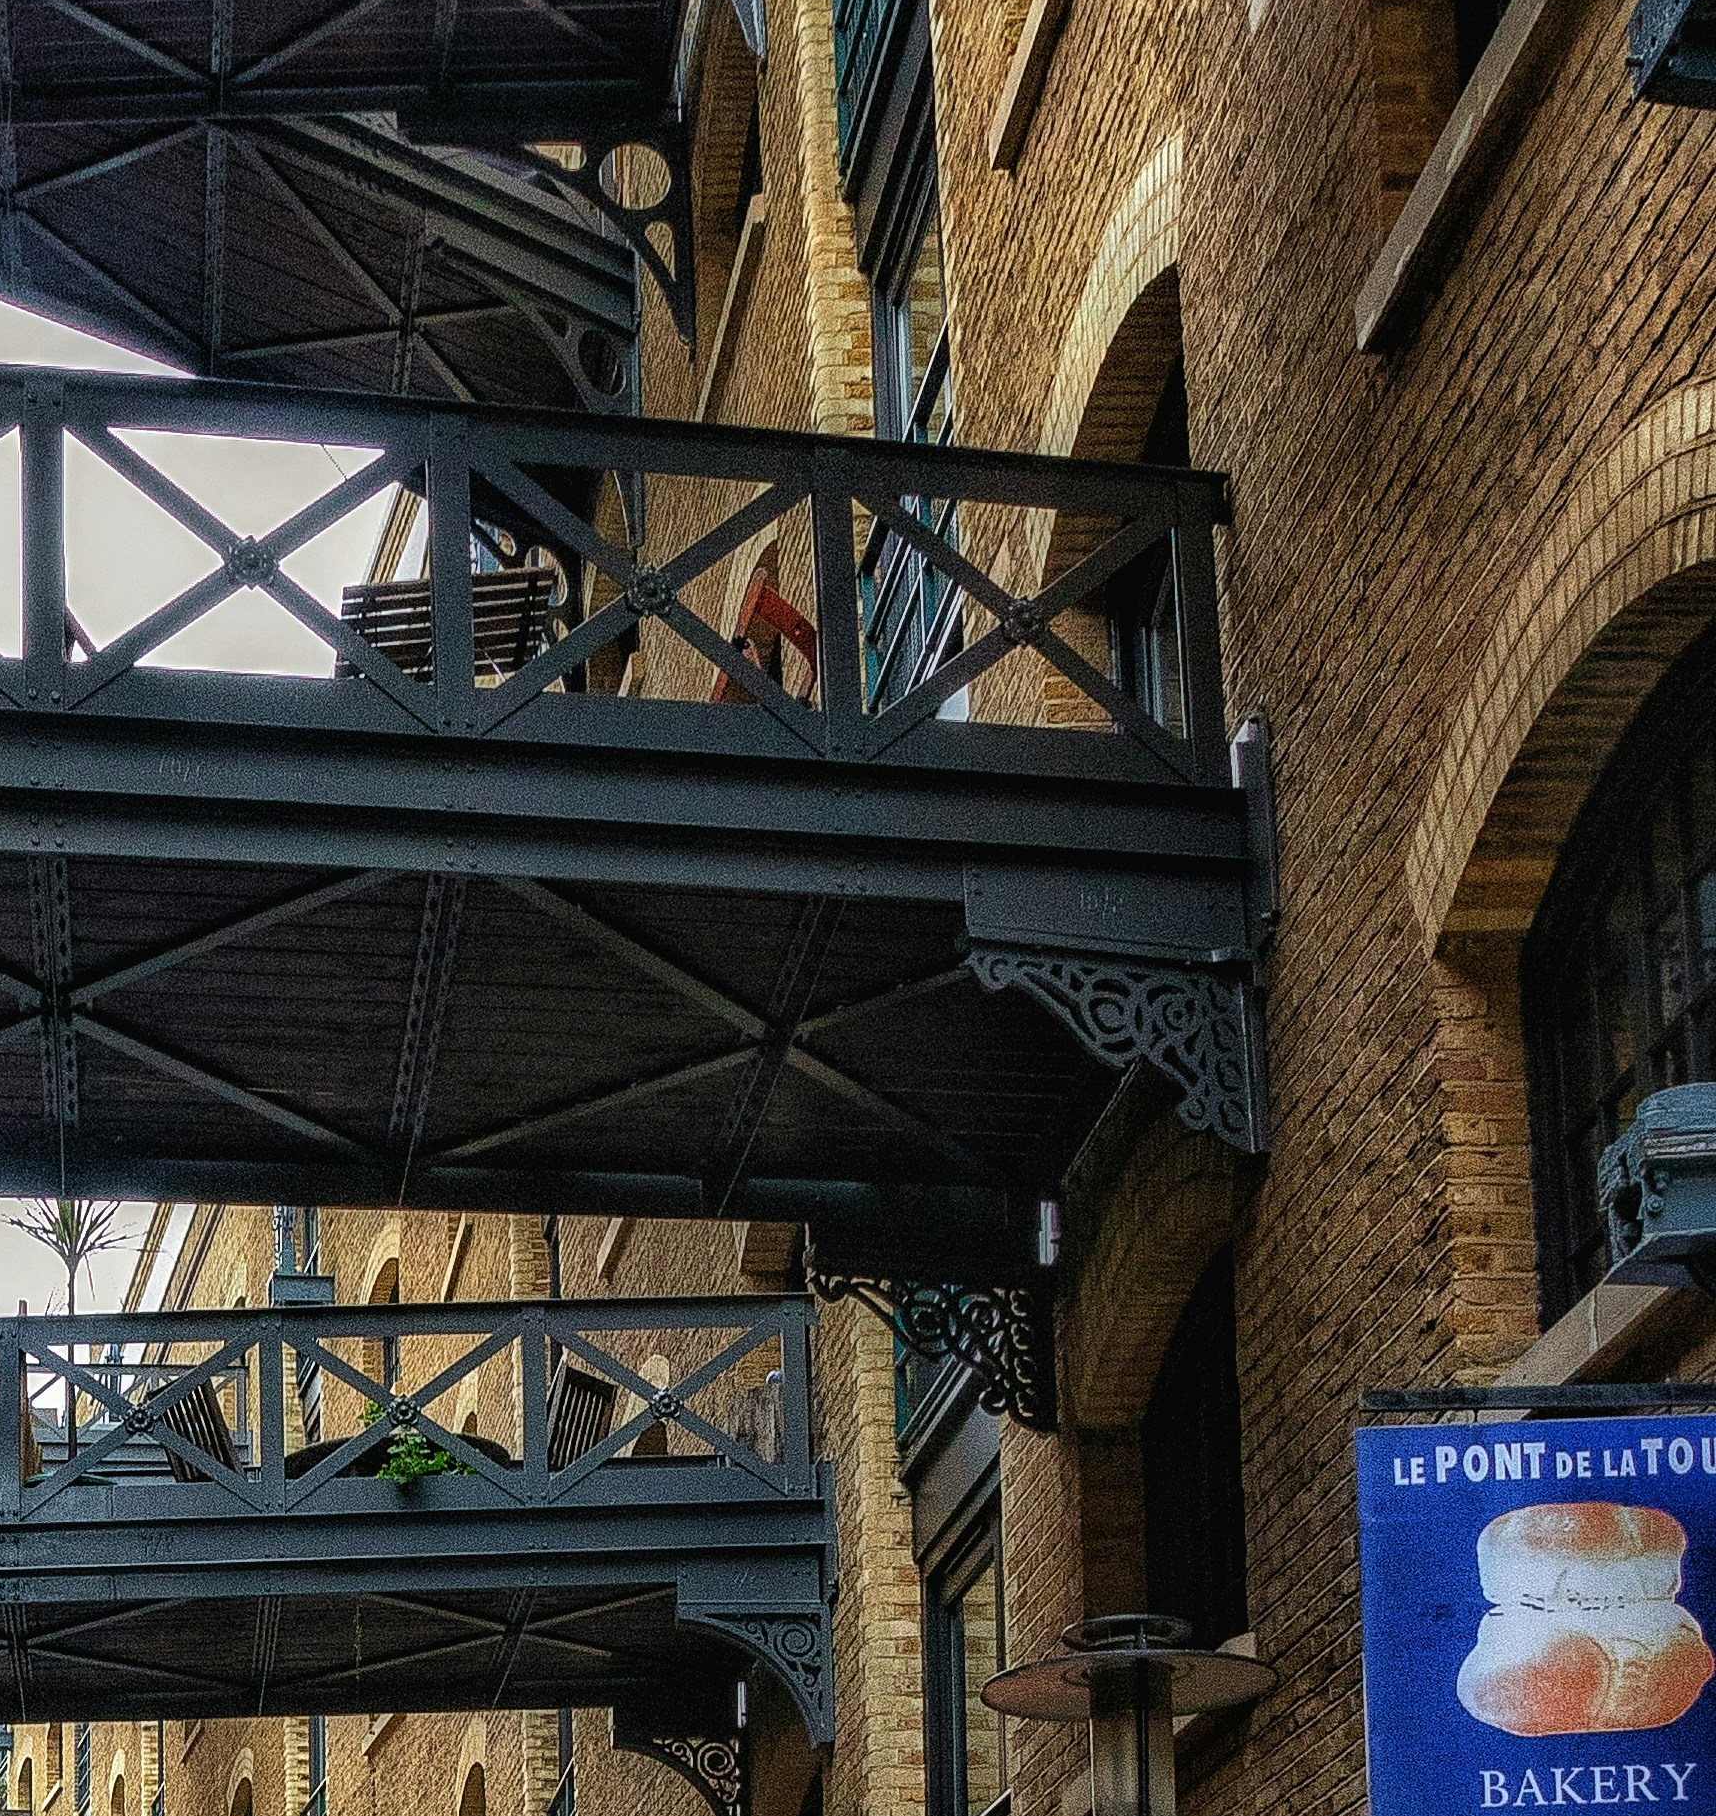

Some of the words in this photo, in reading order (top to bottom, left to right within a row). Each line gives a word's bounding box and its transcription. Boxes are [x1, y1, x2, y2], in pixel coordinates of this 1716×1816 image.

[1393, 1456, 1426, 1486] LE
[1435, 1441, 1546, 1483] PONT
[1556, 1449, 1593, 1479] DE
[1603, 1448, 1638, 1478] LA
[1480, 1762, 1698, 1809] BAKERY
